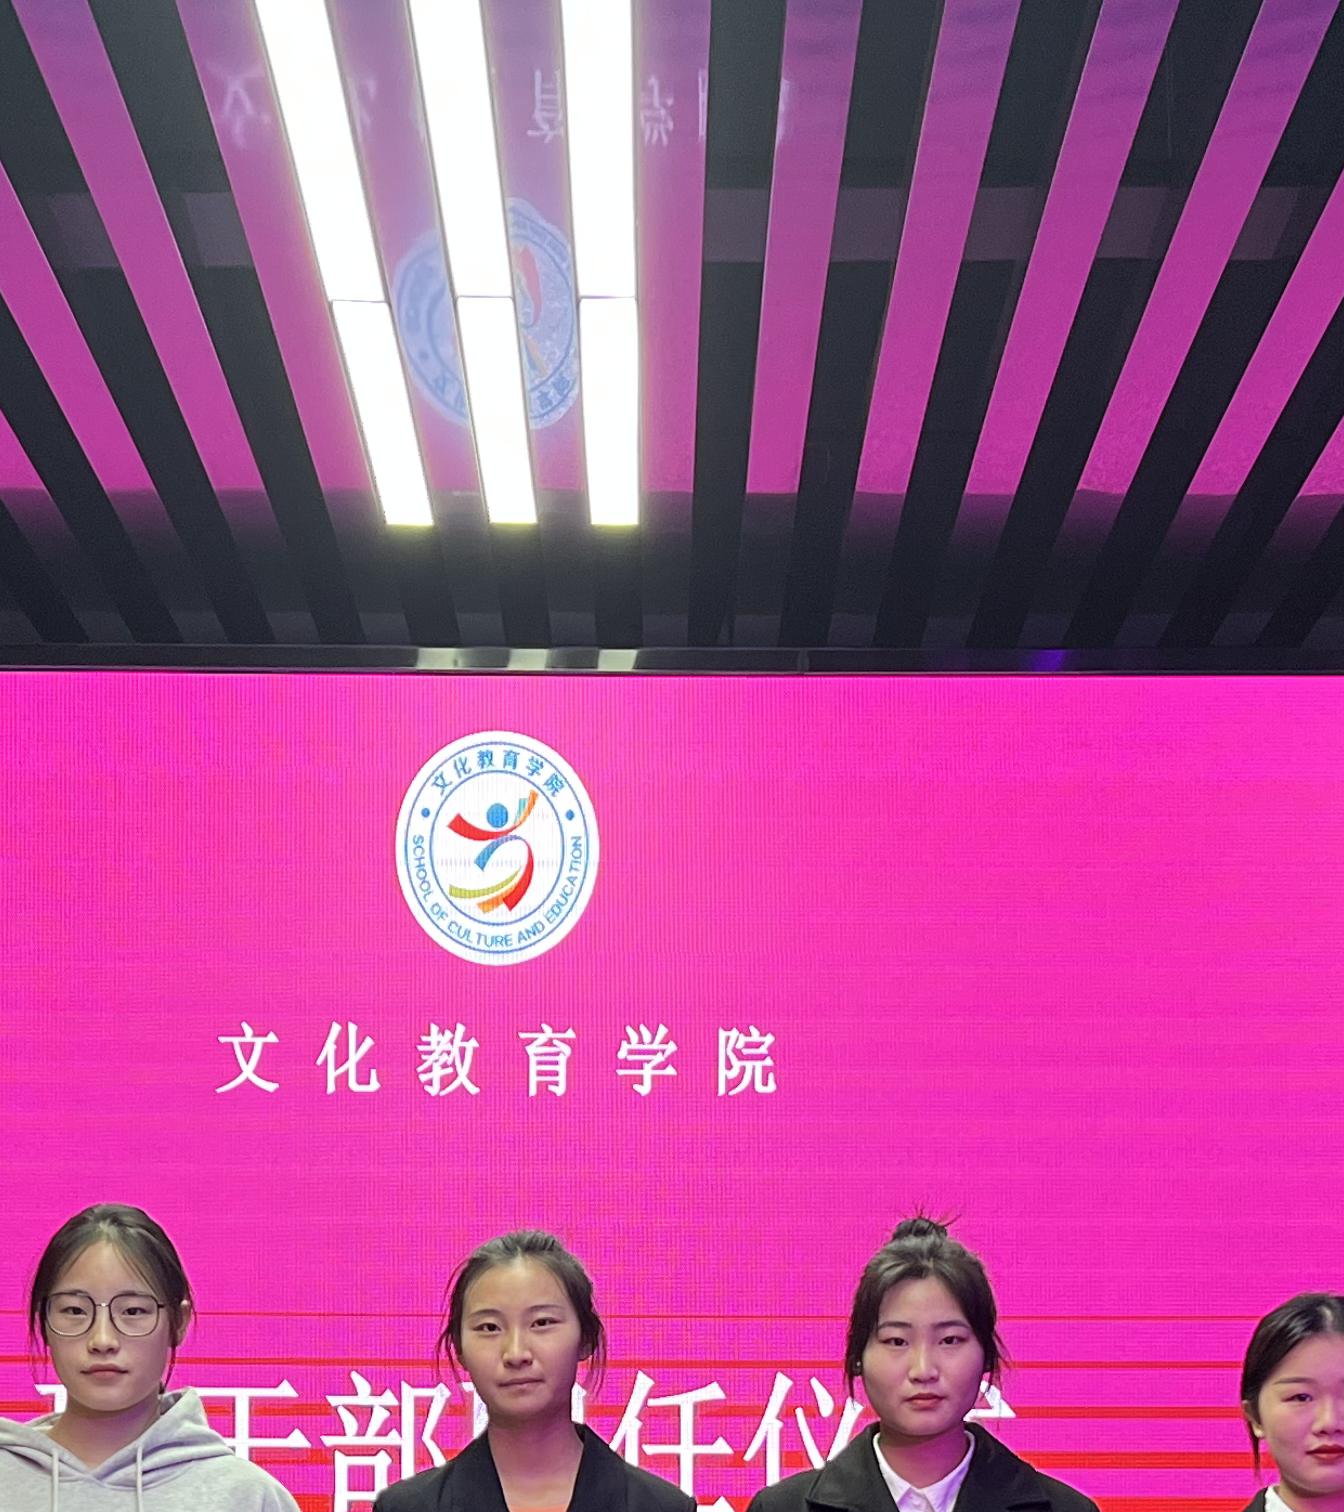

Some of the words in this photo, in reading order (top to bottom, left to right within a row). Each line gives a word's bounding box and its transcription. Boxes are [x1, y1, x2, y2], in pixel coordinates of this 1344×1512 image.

[431, 749, 565, 797] 文化教育学院
[413, 834, 434, 902] SCHOOL
[430, 902, 447, 922] OF
[448, 921, 513, 947] CULTURE
[517, 921, 545, 943] AND
[544, 836, 582, 924] EDUCATION
[215, 1020, 776, 1097] 文化教育学院
